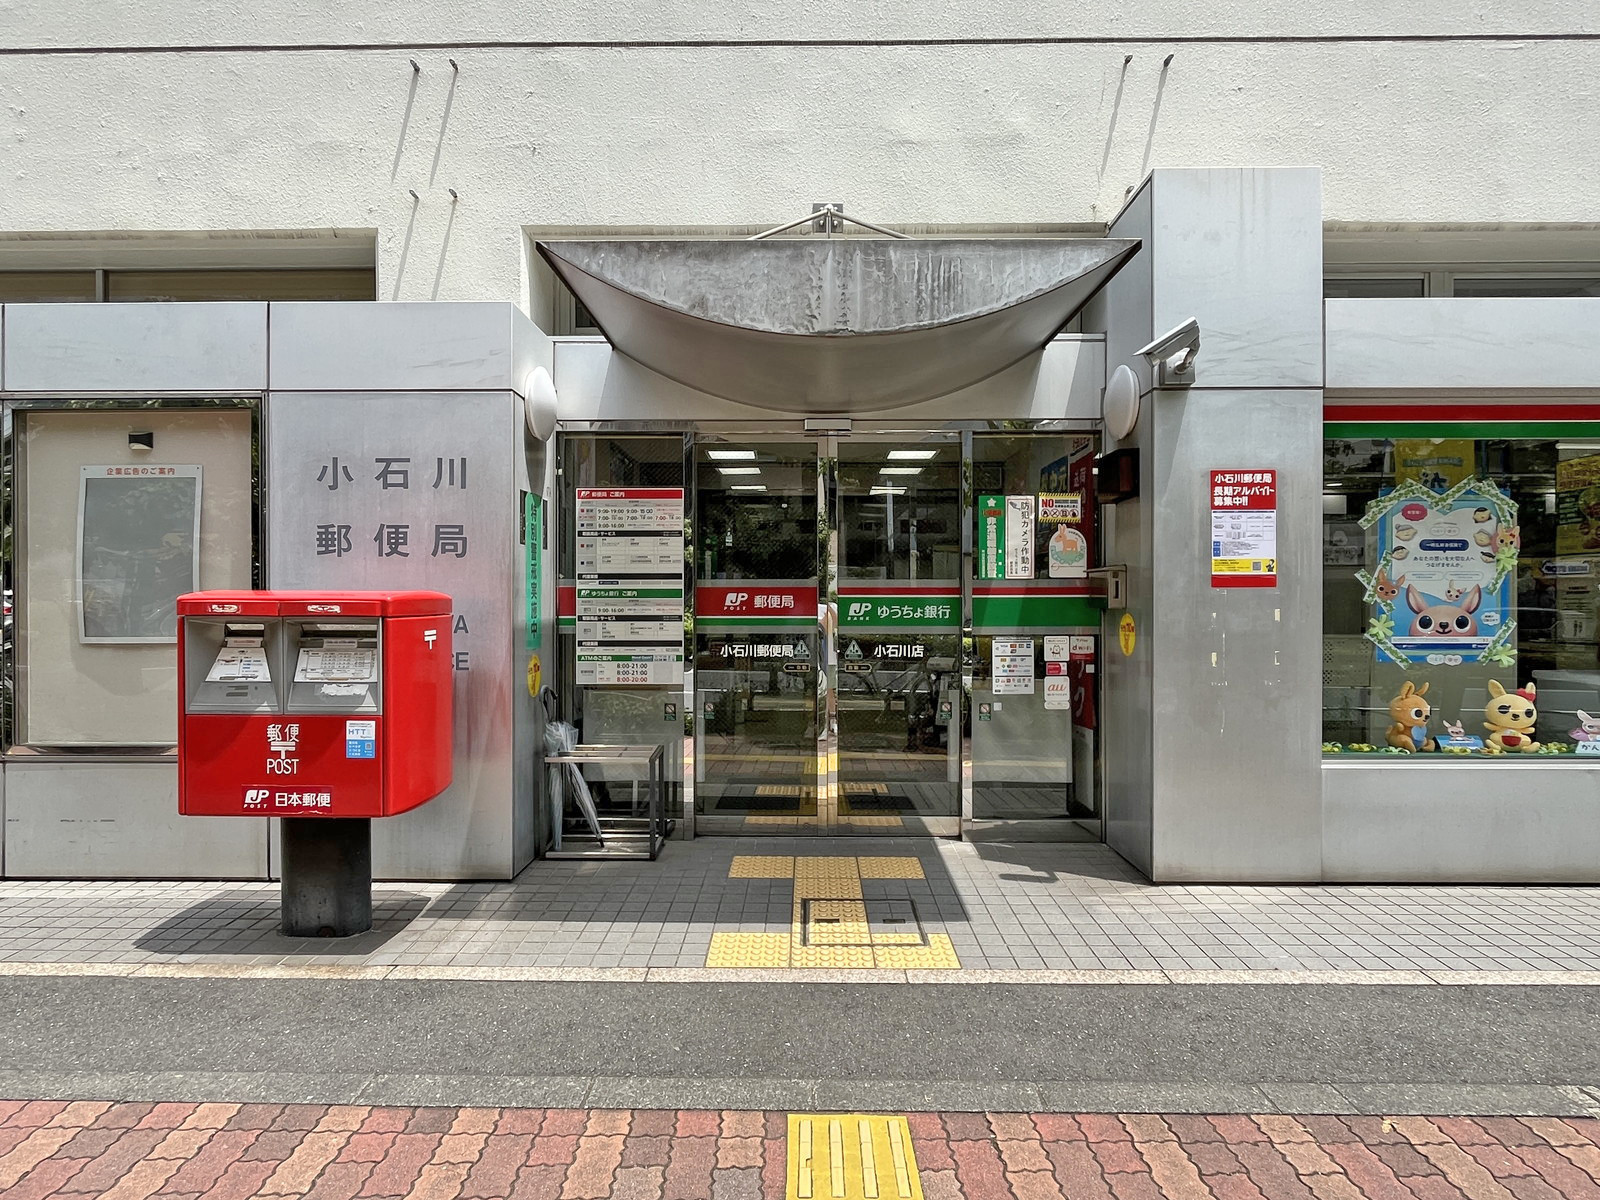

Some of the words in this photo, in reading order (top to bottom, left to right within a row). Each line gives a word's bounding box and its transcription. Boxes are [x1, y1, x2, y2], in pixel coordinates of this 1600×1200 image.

[106, 467, 176, 475] 企業広告のご案内
[316, 456, 467, 490] 小石川
[1214, 473, 1272, 483] 小石川郵便局
[1213, 486, 1275, 496] 長期アルバイト
[1041, 499, 1055, 508] NO
[316, 523, 468, 558] 郵便局
[1020, 501, 1030, 574] 防犯カメラ作動中
[754, 595, 795, 609] 郵便局
[877, 605, 952, 619] ゆうちょ銀行
[720, 645, 794, 658] 小石川郵便局
[874, 645, 925, 658] 小石川店
[1047, 683, 1066, 692] au
[266, 723, 300, 742] 郵便
[266, 758, 300, 774] POST
[275, 792, 331, 807] 日本郵便
